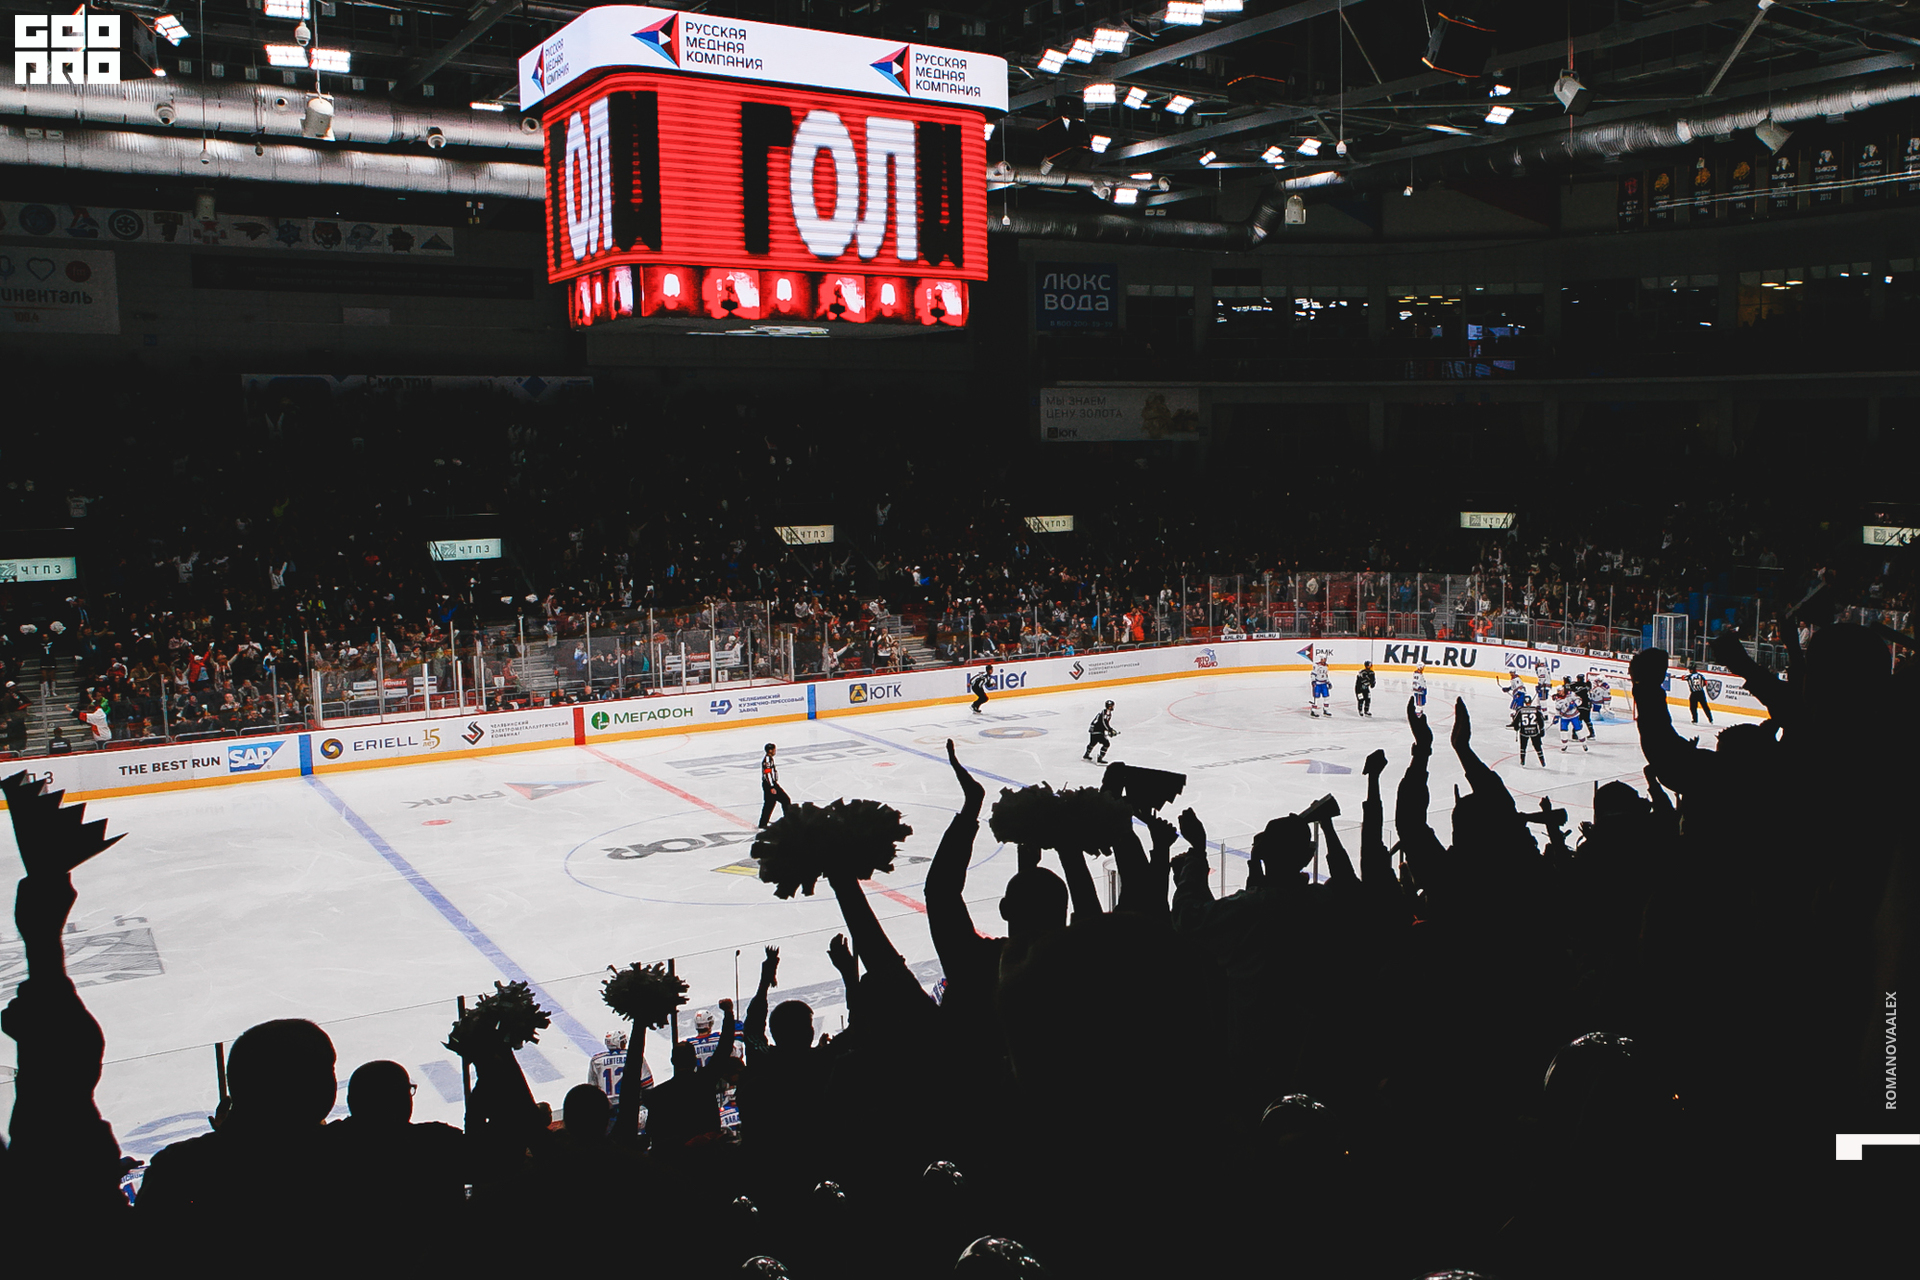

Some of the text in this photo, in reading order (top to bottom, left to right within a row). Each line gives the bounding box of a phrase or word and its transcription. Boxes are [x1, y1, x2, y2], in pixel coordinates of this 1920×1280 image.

[685, 21, 747, 41] РУССКАЯ
[685, 36, 745, 54] МЕДНАЯ
[686, 50, 763, 71] КОМПАНИЯ
[915, 53, 967, 70] РУССКАЯ
[915, 66, 966, 82] МЕДНАЯ
[915, 79, 981, 97] КОМПАНИЯ
[1043, 273, 1111, 291] ЛЮКС
[1, 288, 93, 305] иненталь
[14, 312, 40, 323] 100.4
[1046, 396, 1107, 406] МЫ ЗНАЕМ
[1046, 408, 1123, 421] ЦЕНУ ЗОЛОТА
[801, 530, 825, 538] ЧТПЗ
[459, 545, 490, 554] ЧТПЗ
[21, 565, 61, 575] ЧТПЗ
[1384, 644, 1477, 667] KHL.RU
[870, 684, 902, 700] ЮГК
[1521, 713, 1537, 726] 52
[354, 736, 419, 752] ERIELL
[422, 728, 440, 750] 15
[228, 747, 273, 768] SAP
[119, 756, 221, 776] THE BEST RUN
[724, 1112, 742, 1125] BARA
